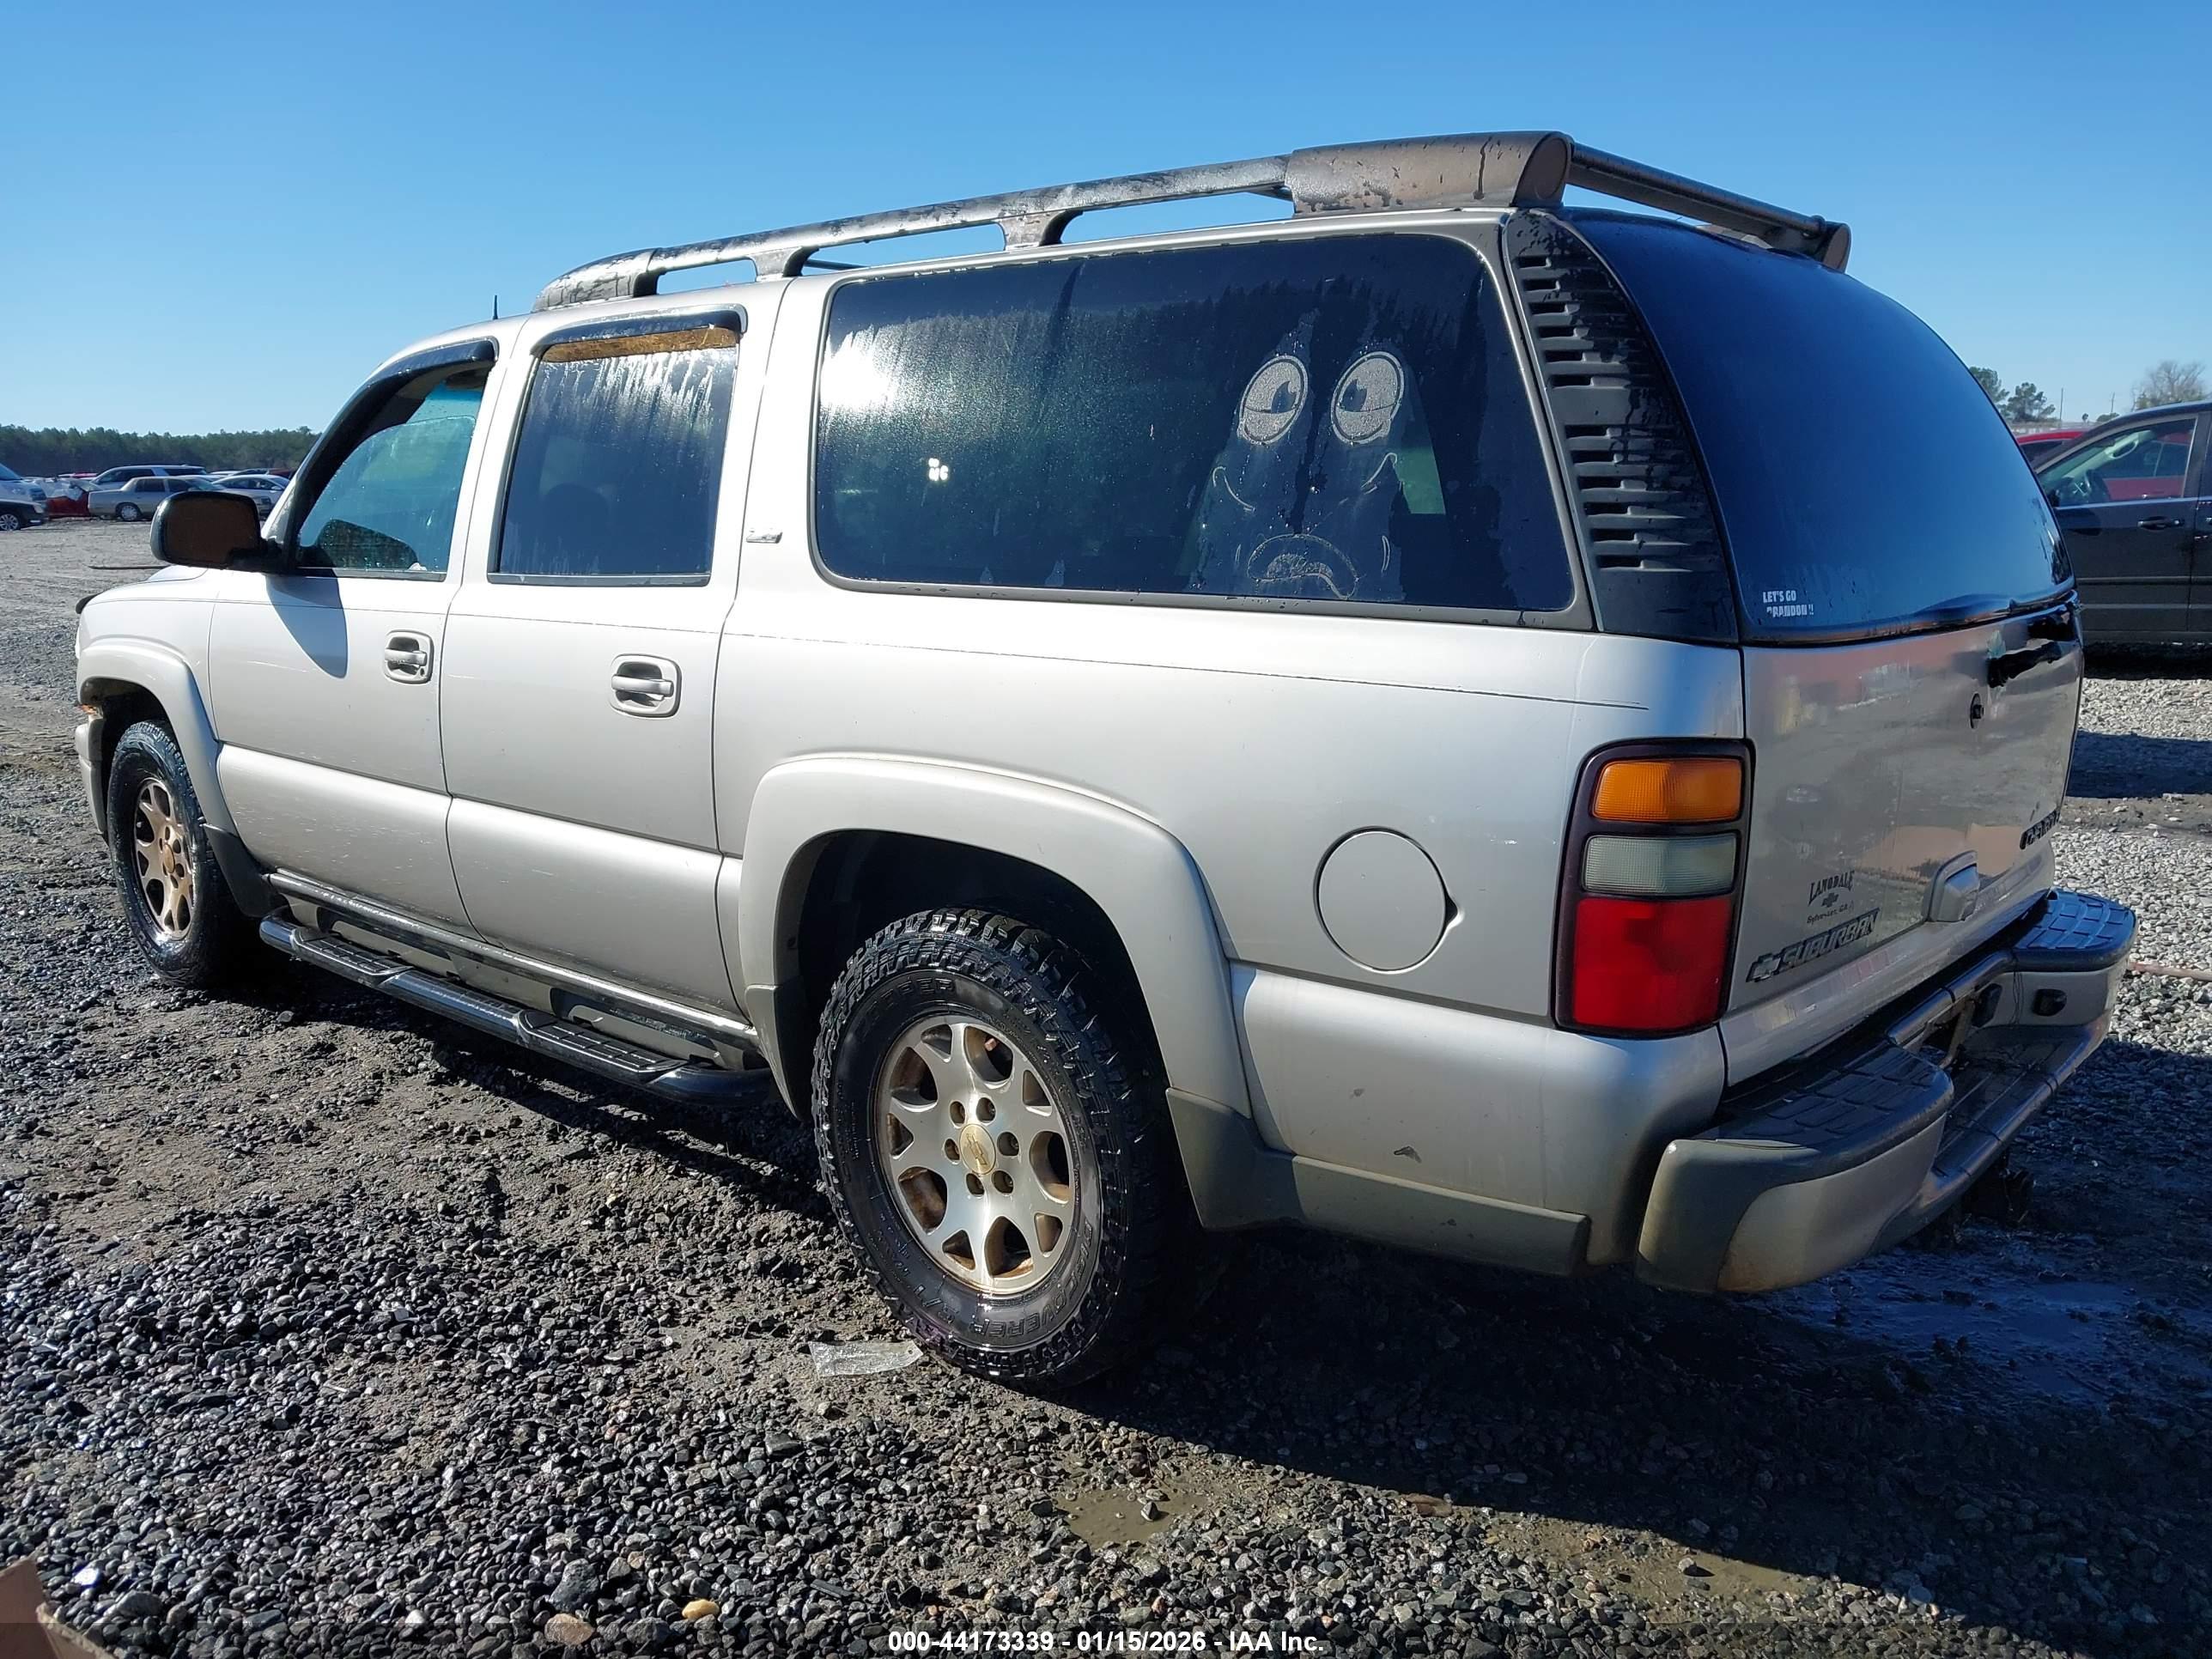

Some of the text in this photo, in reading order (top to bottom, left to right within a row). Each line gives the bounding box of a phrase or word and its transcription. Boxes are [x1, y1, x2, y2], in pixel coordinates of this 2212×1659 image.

[1762, 590, 1797, 603] LET'S GO
[1781, 908, 1881, 969] SUBURBAN
[969, 1218, 1093, 1339] DISCOVERER
